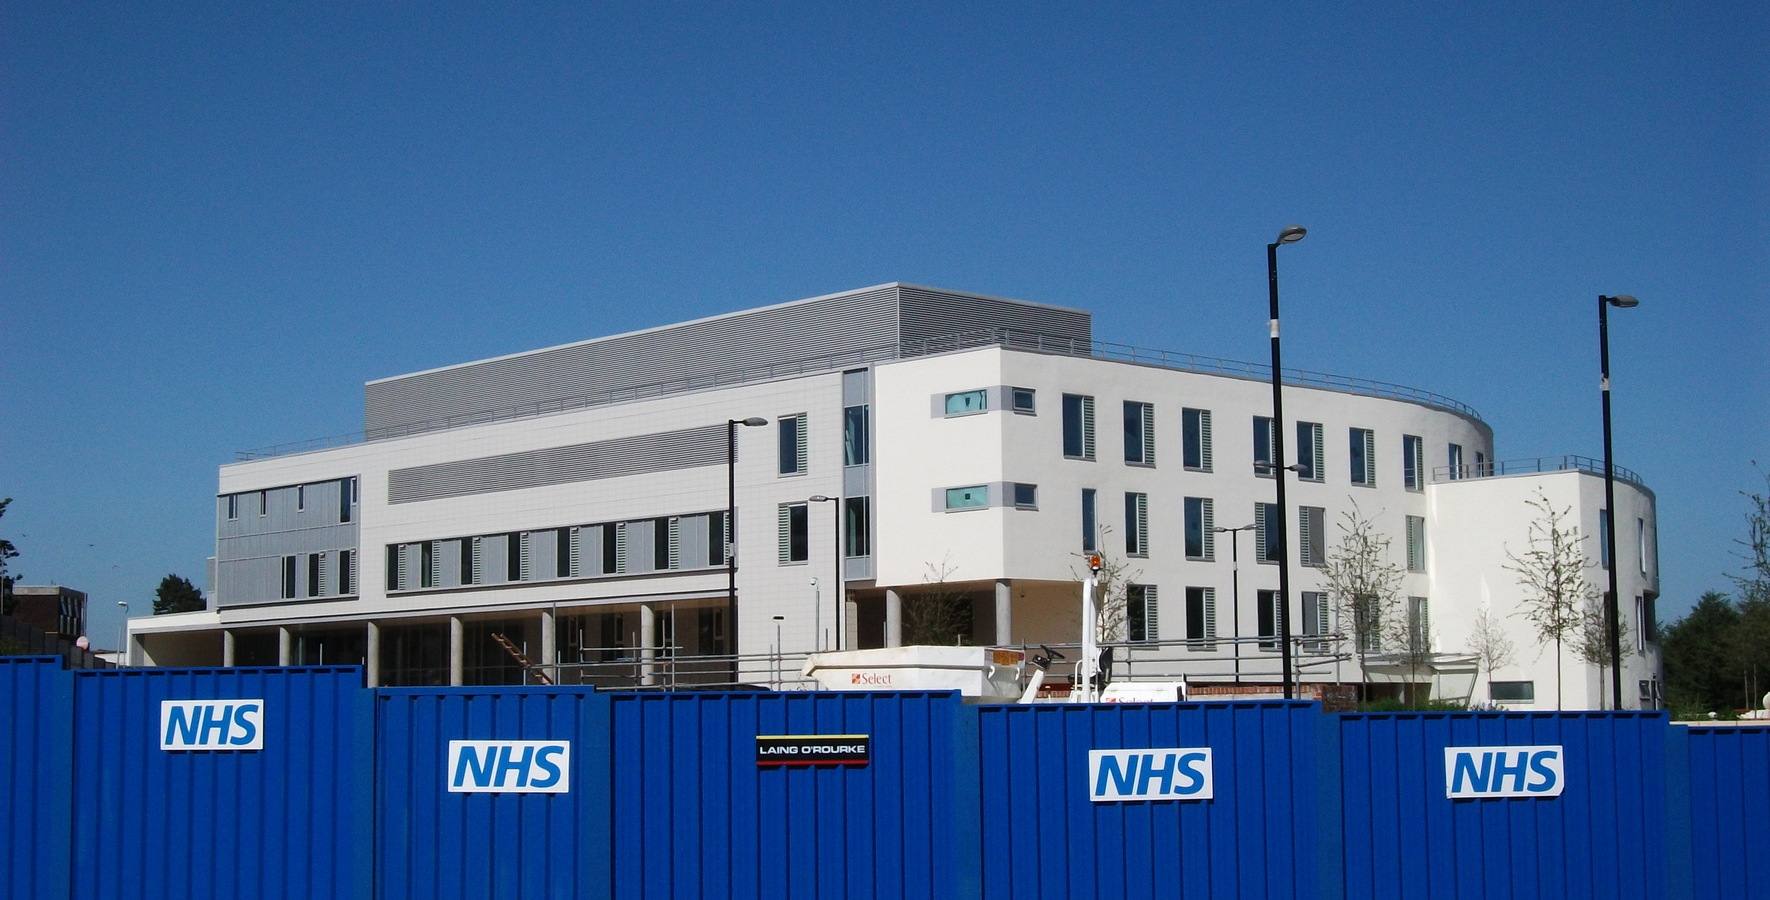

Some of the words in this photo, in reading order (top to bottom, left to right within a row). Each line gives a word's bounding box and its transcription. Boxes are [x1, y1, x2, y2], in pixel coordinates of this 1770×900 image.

[862, 672, 892, 685] Select
[165, 704, 259, 746] NHS
[453, 745, 565, 788] NHS
[760, 745, 799, 755] LAING
[801, 745, 866, 754] O'ROURKE
[1095, 753, 1207, 797] NHS
[1450, 750, 1558, 793] NHS
